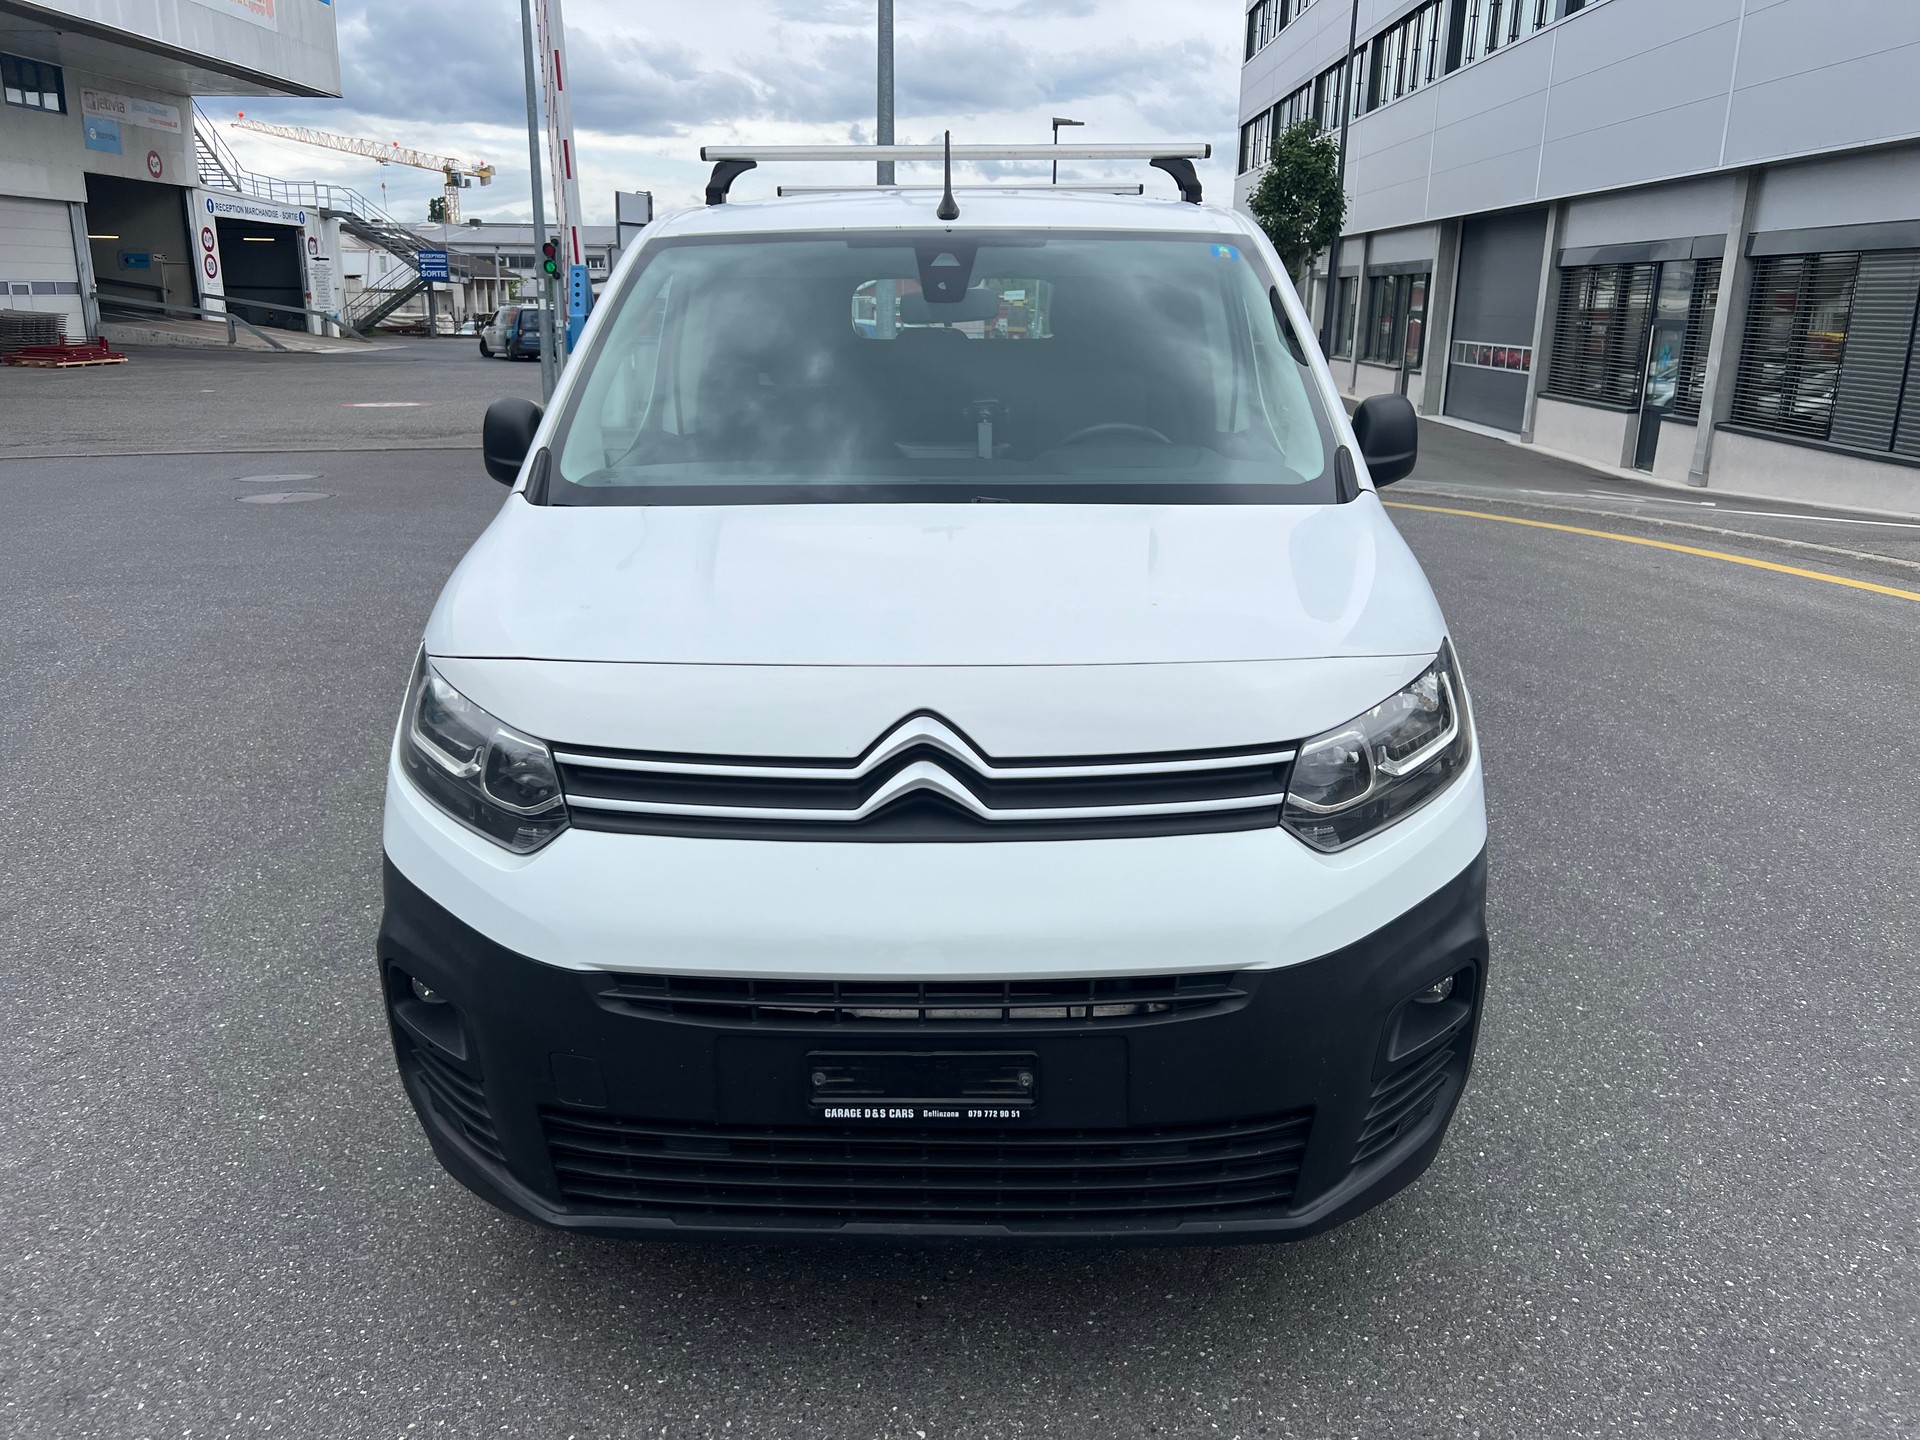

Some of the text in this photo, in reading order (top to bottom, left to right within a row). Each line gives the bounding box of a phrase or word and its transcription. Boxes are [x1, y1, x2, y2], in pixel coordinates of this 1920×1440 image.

[215, 203, 244, 214] RECEPTION
[245, 206, 279, 219] MARCHANDISE
[282, 211, 298, 221] SORTIE
[208, 261, 215, 271] 30
[421, 270, 448, 278] SORTIE
[825, 1108, 862, 1118] GARAGE
[889, 1108, 914, 1118] CARS
[923, 1109, 960, 1118] Bellinzona
[968, 1109, 982, 1118] 079
[984, 1109, 998, 1118] 772
[999, 1109, 1010, 1118] 90
[1011, 1109, 1020, 1118] 51
